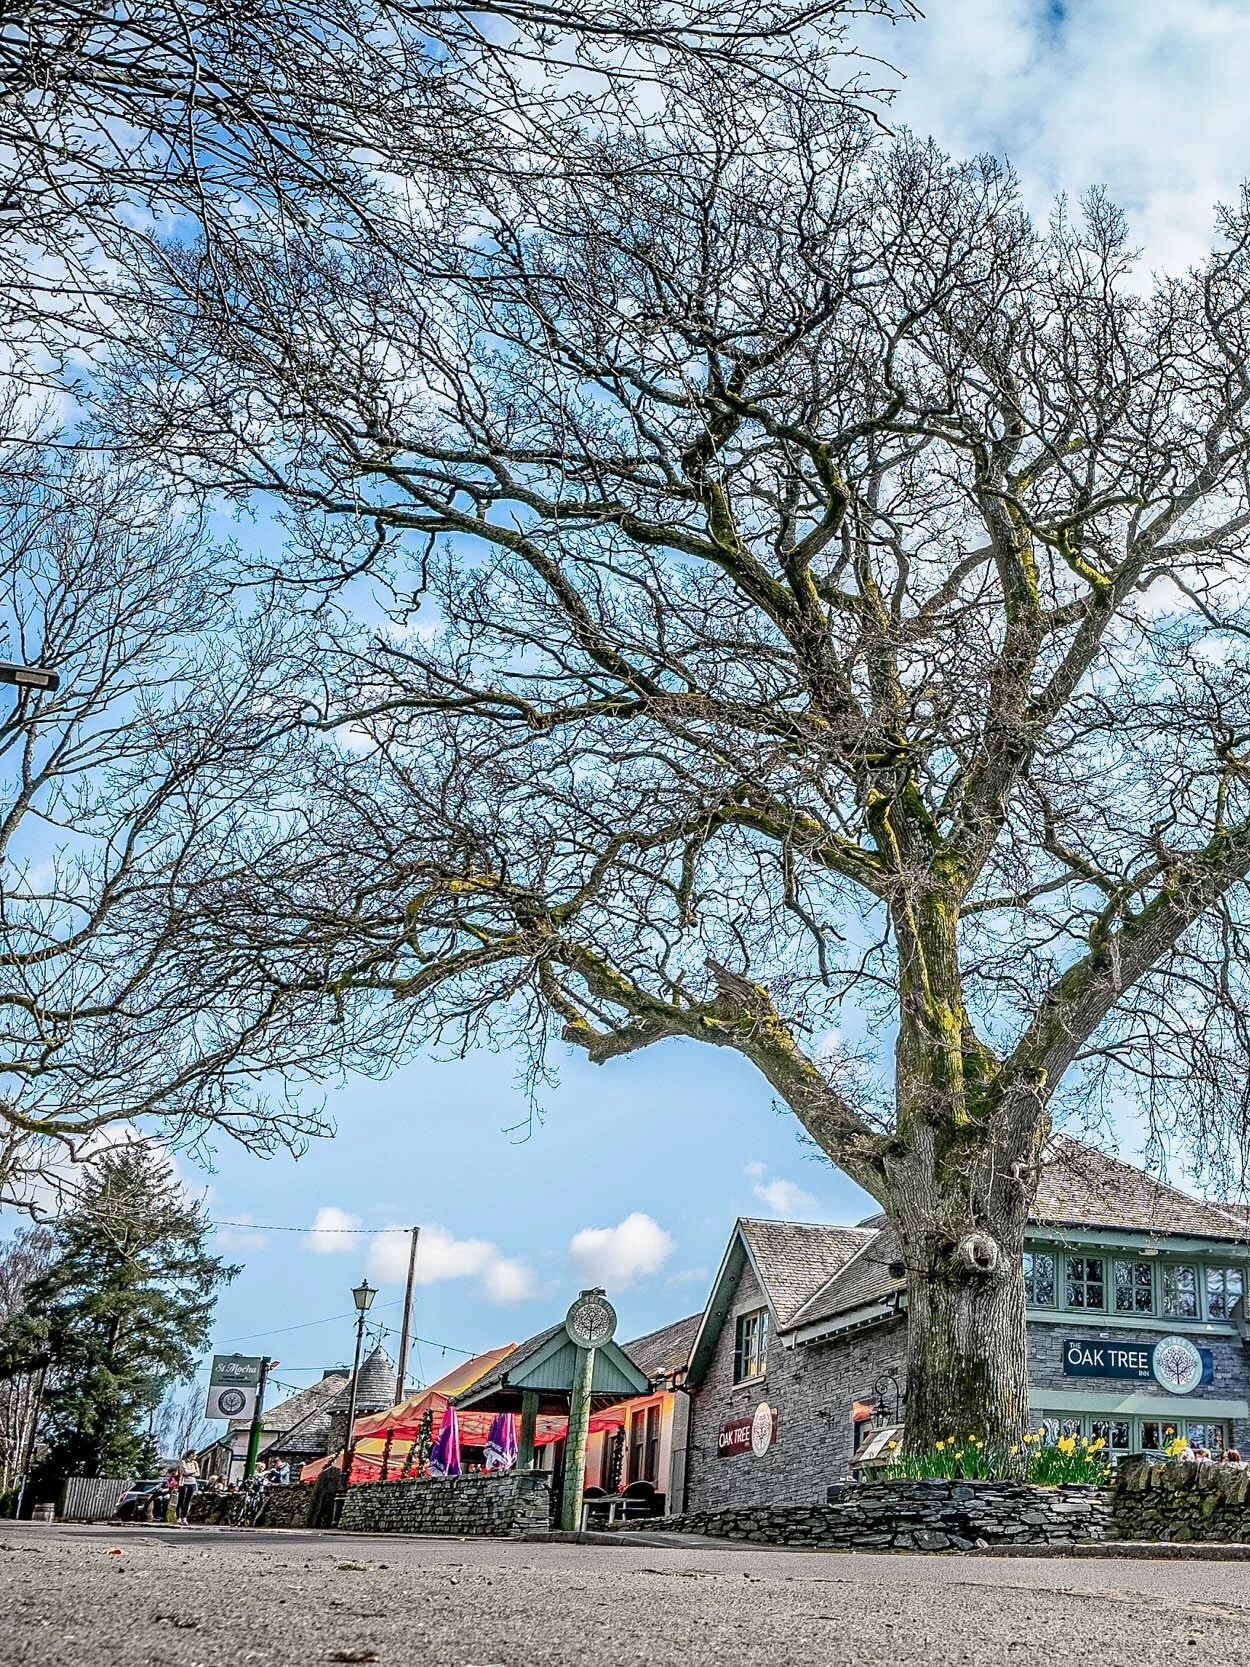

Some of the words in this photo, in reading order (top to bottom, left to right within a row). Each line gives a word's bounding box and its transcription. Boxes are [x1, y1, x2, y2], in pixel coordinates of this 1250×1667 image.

[1168, 1337, 1187, 1346] TREE
[1068, 1348, 1104, 1367] OAK
[1107, 1350, 1148, 1369] TREE
[226, 1362, 257, 1375] Mocha
[719, 1430, 733, 1448] OAK
[734, 1426, 750, 1444] TREE
